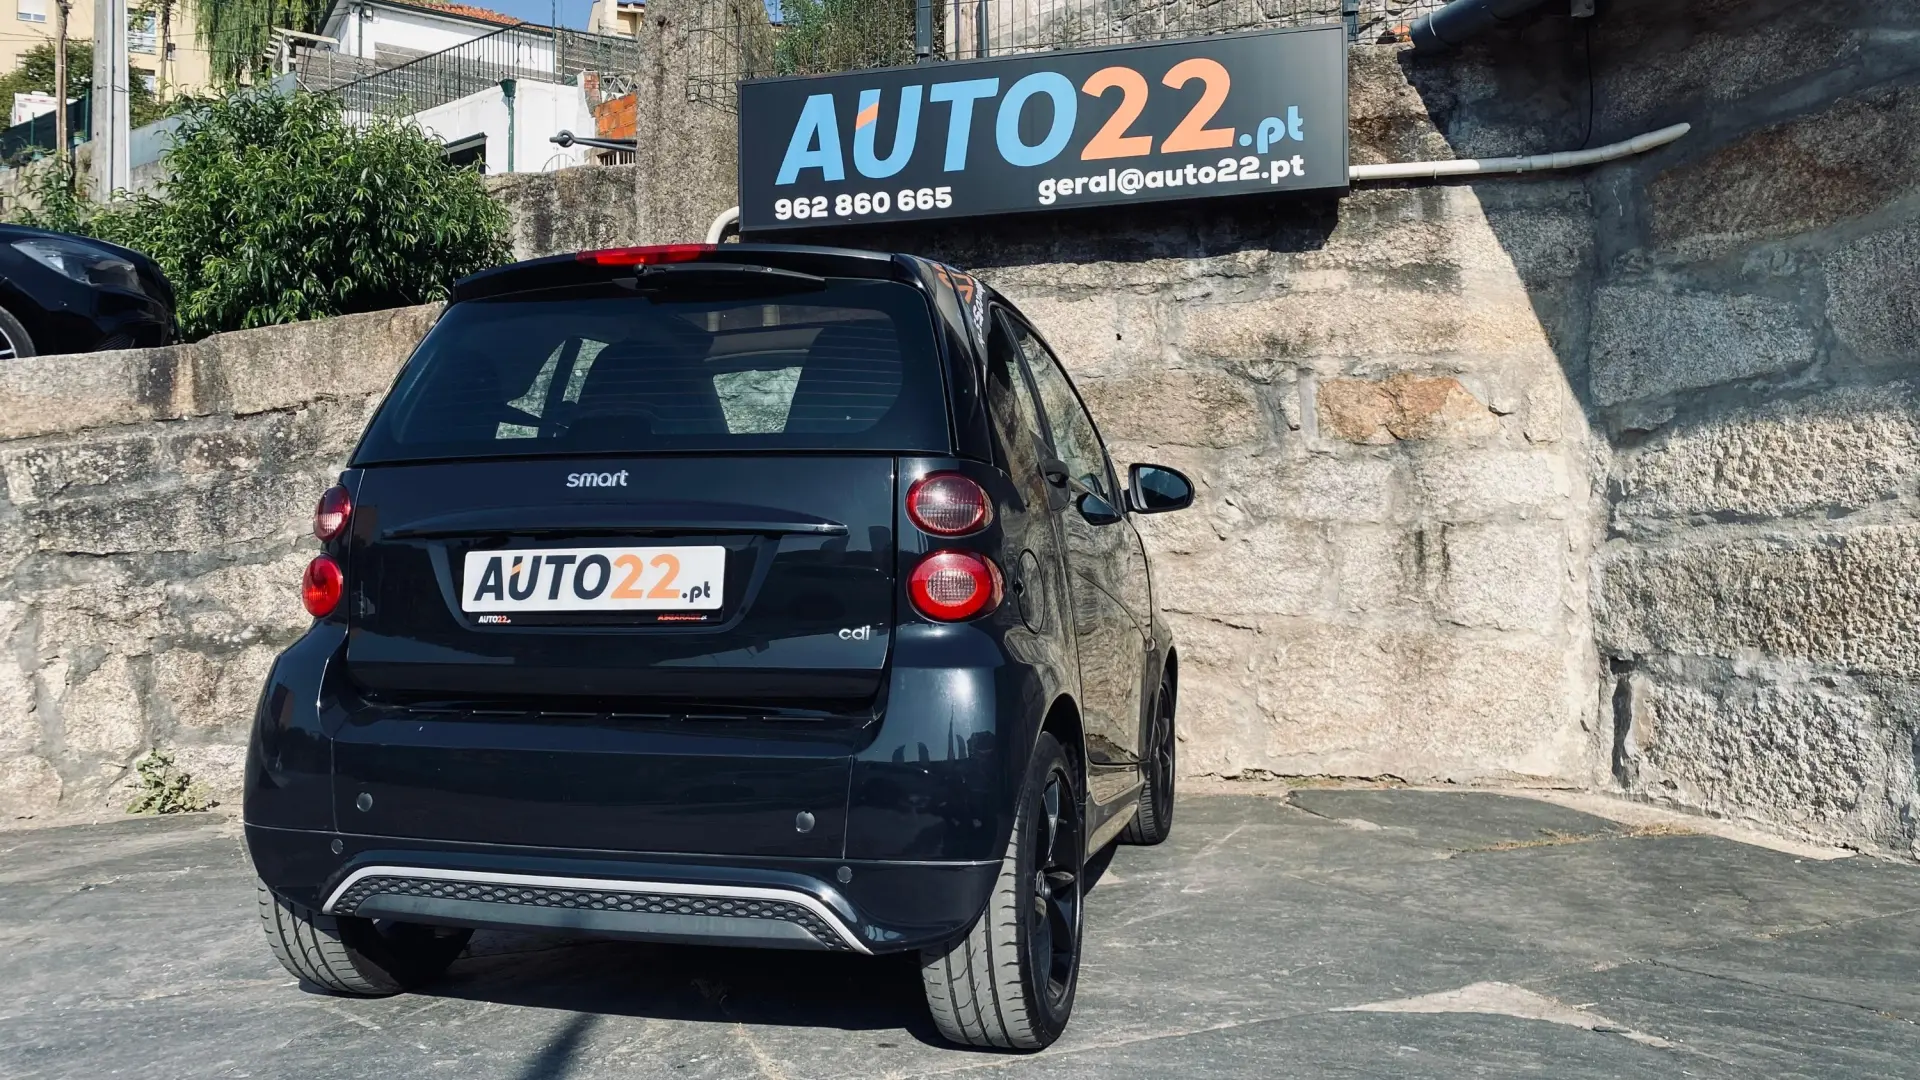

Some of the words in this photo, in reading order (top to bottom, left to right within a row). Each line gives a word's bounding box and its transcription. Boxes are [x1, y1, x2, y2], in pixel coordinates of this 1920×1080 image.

[775, 57, 1305, 185] AUTO22.pt
[1038, 154, 1305, 205] geral@auto22.pt
[774, 196, 829, 221] 962
[834, 191, 891, 217] 860
[897, 186, 953, 212] 665
[566, 469, 629, 488] smart
[473, 553, 711, 604] AUTO22.pt
[478, 614, 512, 624] AUTO22
[838, 624, 871, 641] cdi
